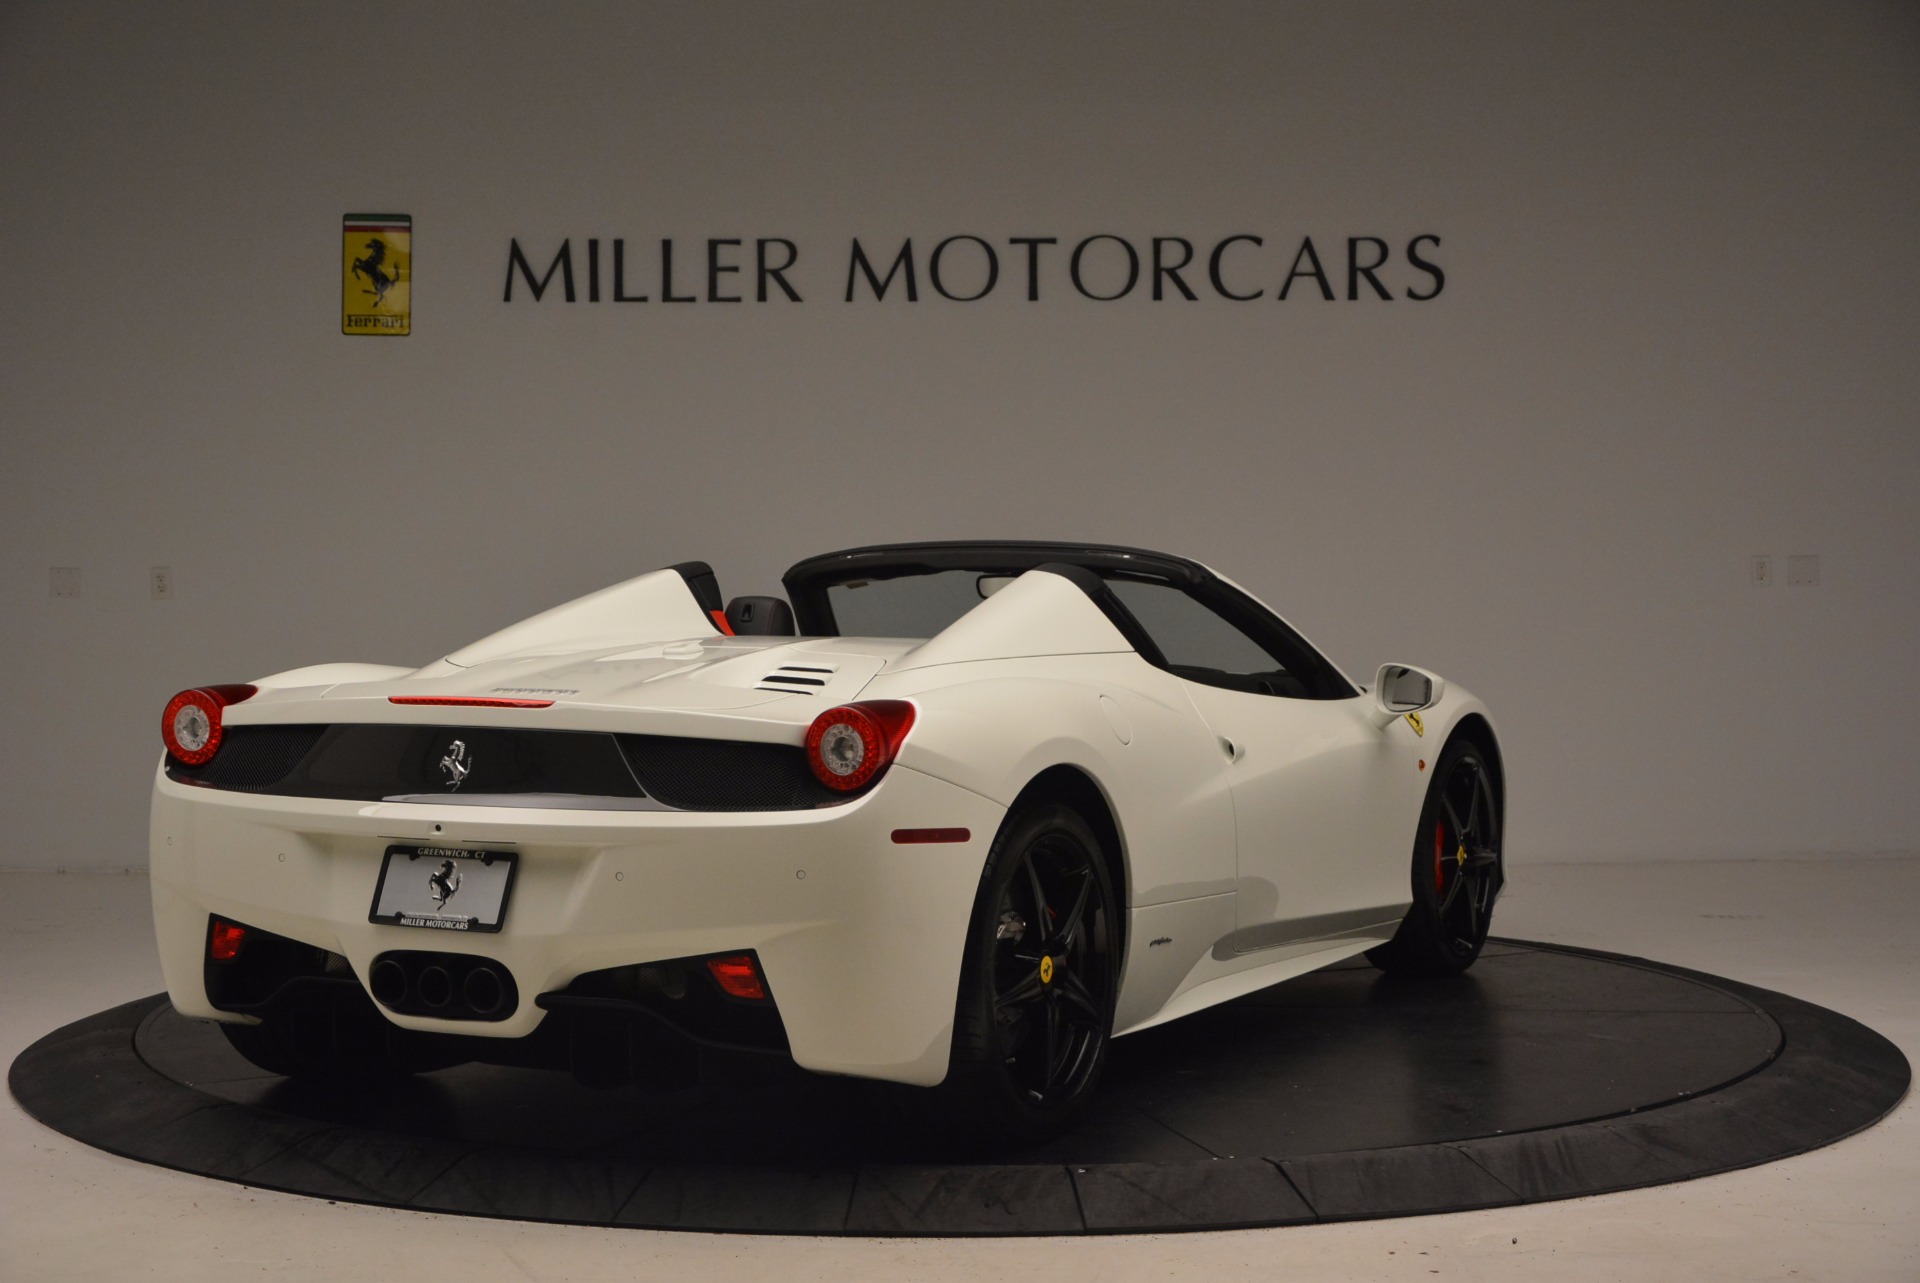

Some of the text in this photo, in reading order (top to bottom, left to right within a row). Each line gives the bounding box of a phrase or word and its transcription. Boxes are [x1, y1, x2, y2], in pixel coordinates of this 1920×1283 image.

[503, 234, 1446, 302] MILLER MOTORCARS
[346, 314, 404, 328] Ferrari
[474, 851, 487, 859] CT
[400, 917, 469, 930] MILLER MOTORCARS
